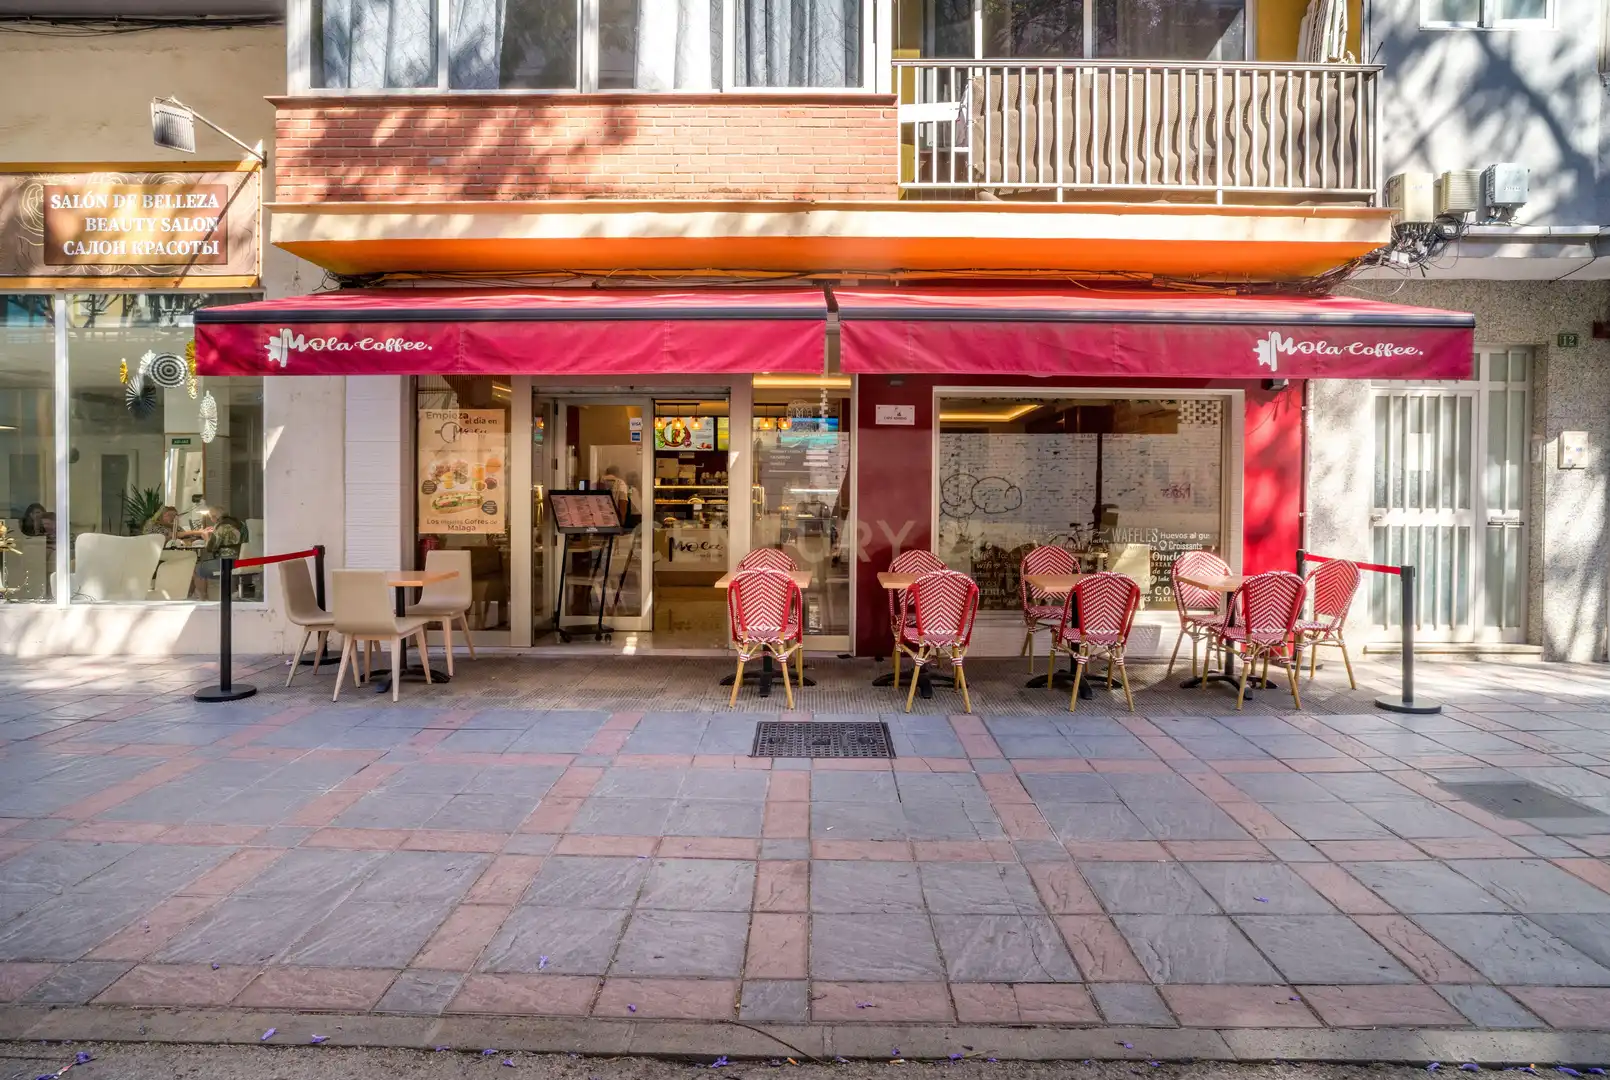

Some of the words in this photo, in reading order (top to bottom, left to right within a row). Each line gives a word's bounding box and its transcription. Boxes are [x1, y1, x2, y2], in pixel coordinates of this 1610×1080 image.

[51, 190, 109, 209] SALÓN
[113, 194, 138, 209] DE
[142, 194, 219, 209] BELLEZA
[85, 217, 156, 232] BEAUTY
[160, 217, 219, 232] SALON
[63, 240, 127, 255] САЛОН
[132, 240, 219, 255] КРАСОТЫ
[278, 328, 353, 367] Mola
[354, 337, 433, 353] Coffee.
[1562, 335, 1575, 346] 12
[1269, 331, 1344, 371] Mola
[1344, 341, 1424, 357] Coffee.
[425, 410, 469, 421] Empieza
[1111, 527, 1159, 543] WAFFLES
[1160, 531, 1188, 540] Huevos
[1189, 532, 1197, 540] al
[1168, 540, 1203, 550] Croissants
